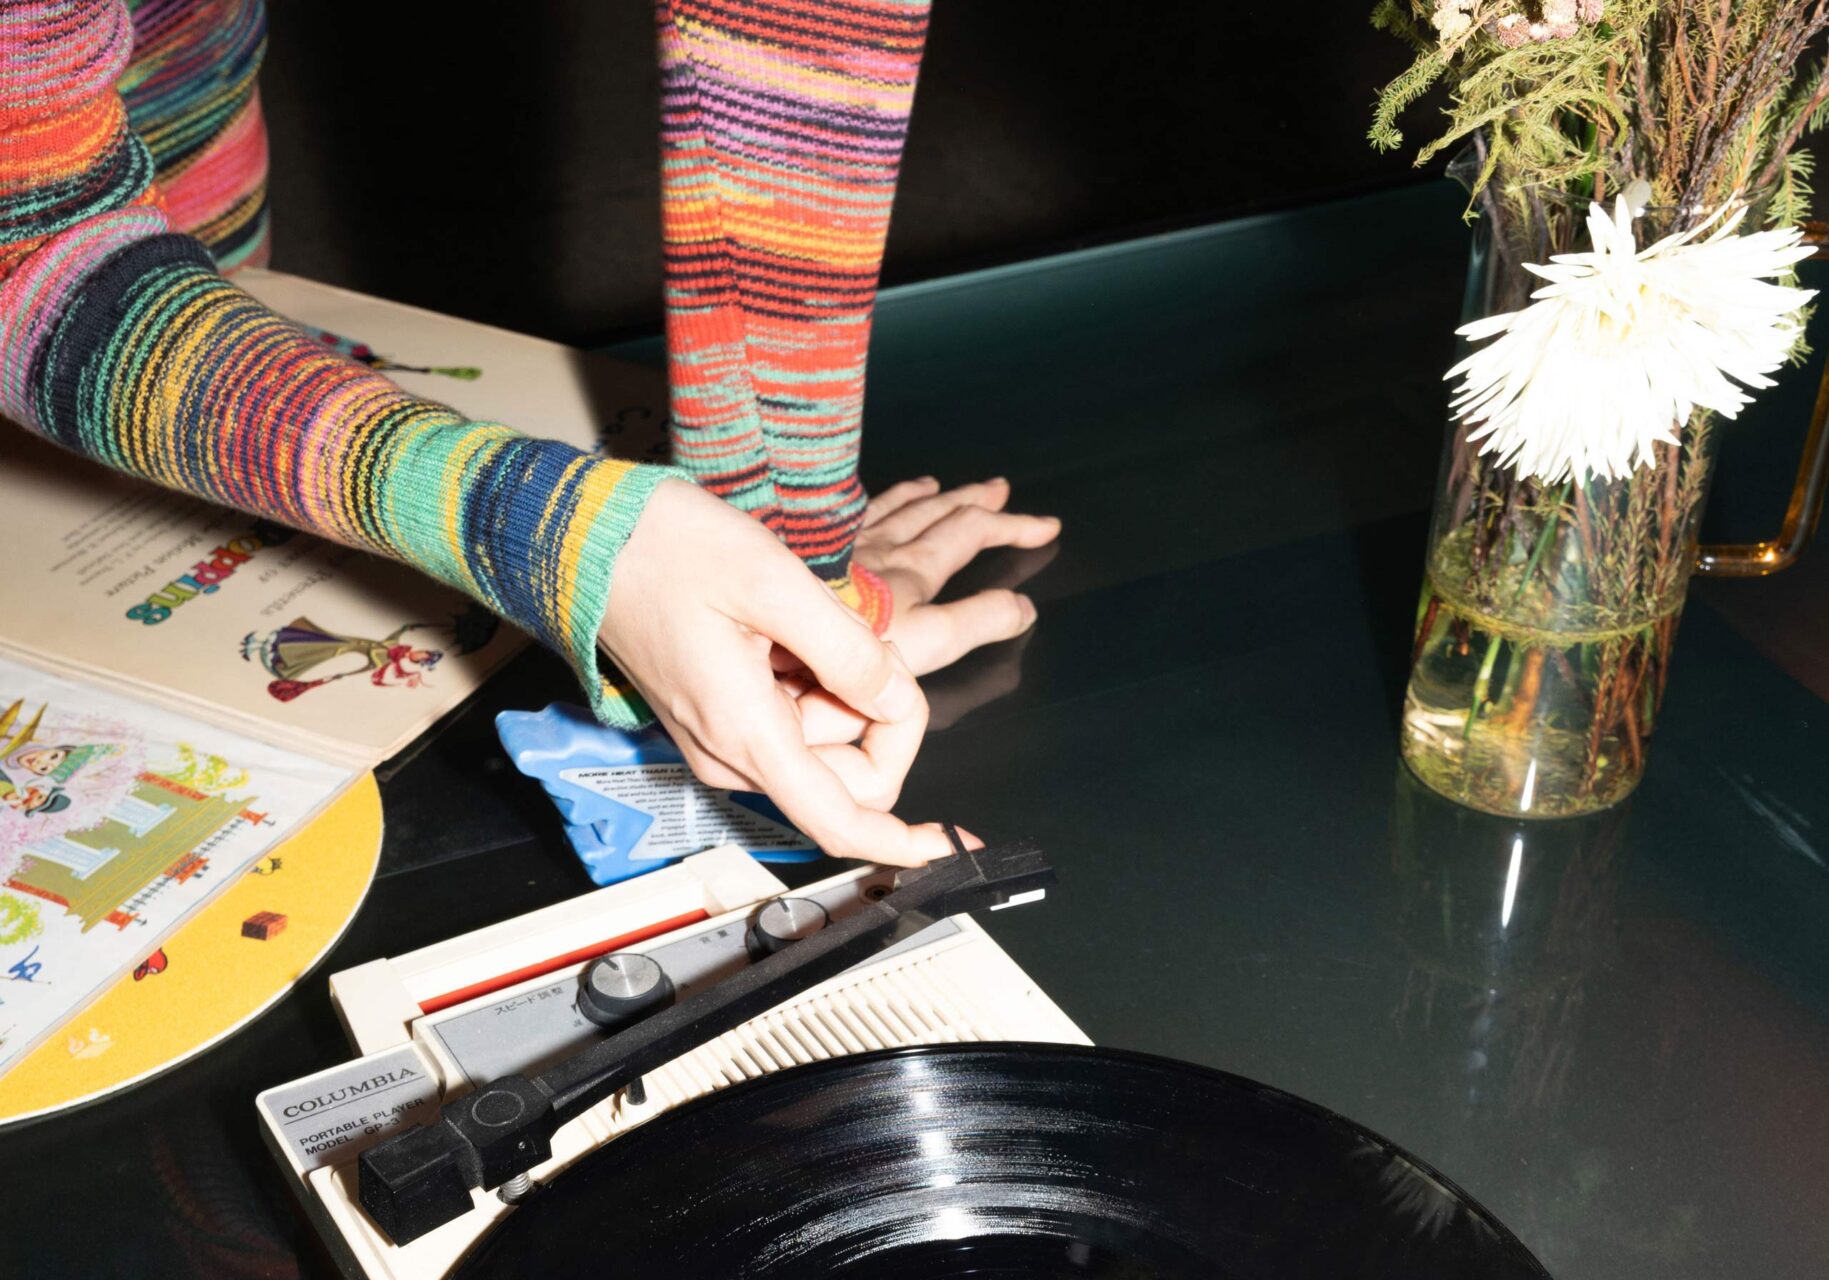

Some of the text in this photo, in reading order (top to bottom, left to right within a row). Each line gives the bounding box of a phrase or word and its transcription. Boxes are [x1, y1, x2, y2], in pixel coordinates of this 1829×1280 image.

[283, 1067, 417, 1118] COLUMBIA
[299, 1098, 424, 1146] PORTABLE PLAYER
[305, 1117, 400, 1155] MODEL GP-3
